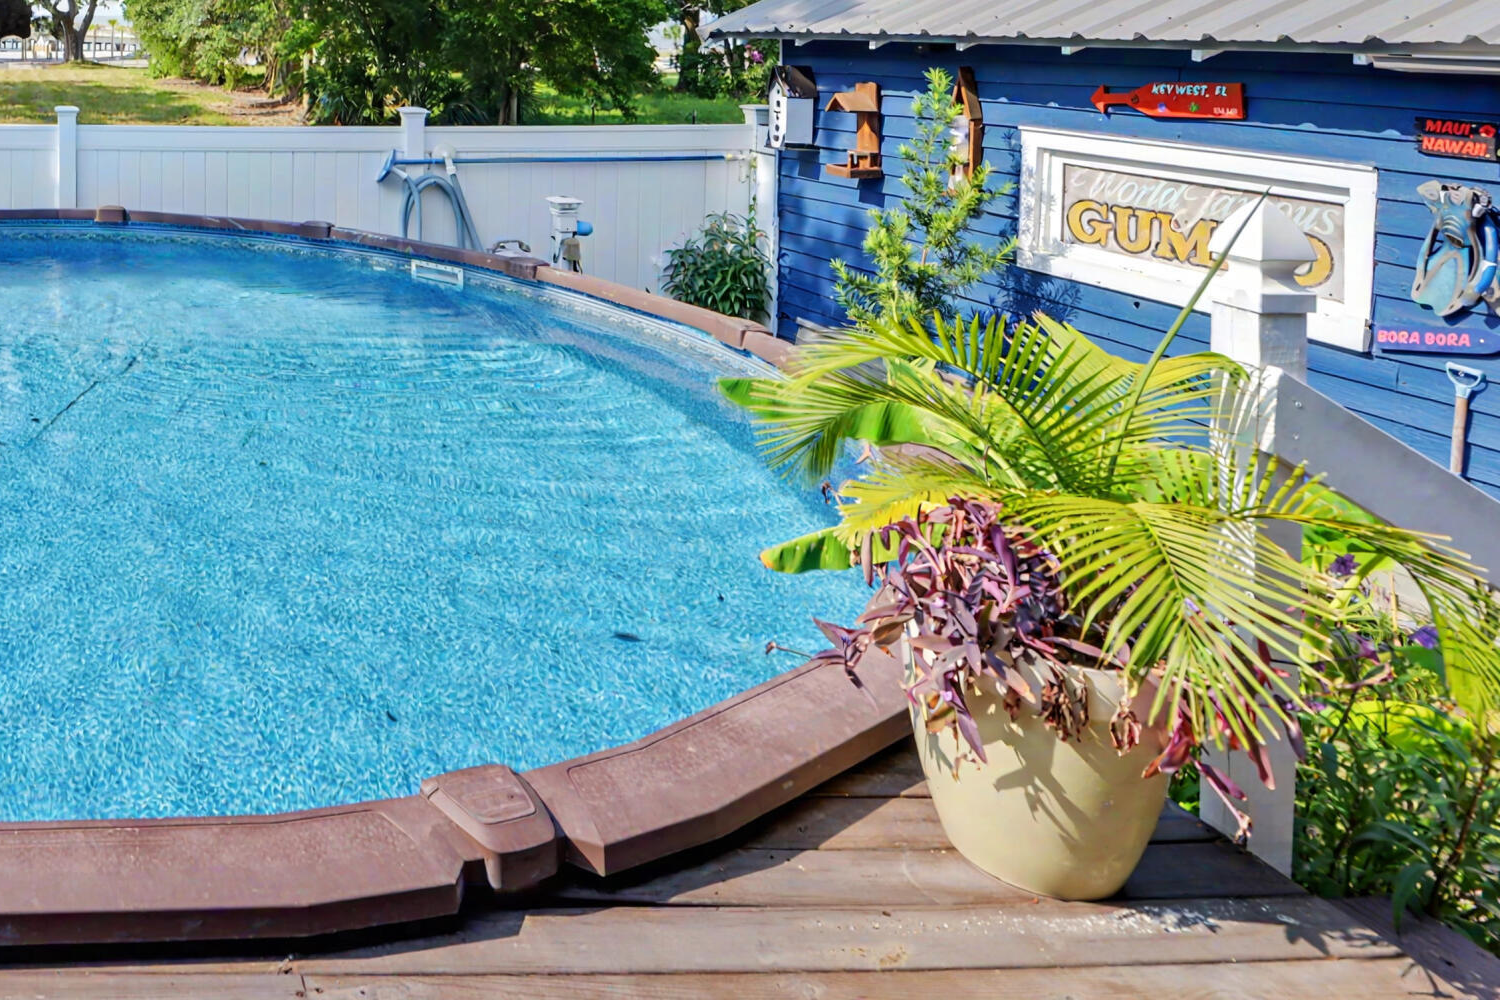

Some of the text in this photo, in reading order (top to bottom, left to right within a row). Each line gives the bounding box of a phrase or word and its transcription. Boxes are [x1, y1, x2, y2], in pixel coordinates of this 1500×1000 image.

[1151, 83, 1174, 95] KEY
[1214, 85, 1227, 97] FL
[1070, 169, 1187, 212] World
[1066, 198, 1335, 288] GUMO
[1377, 330, 1471, 347] BORA BORA
